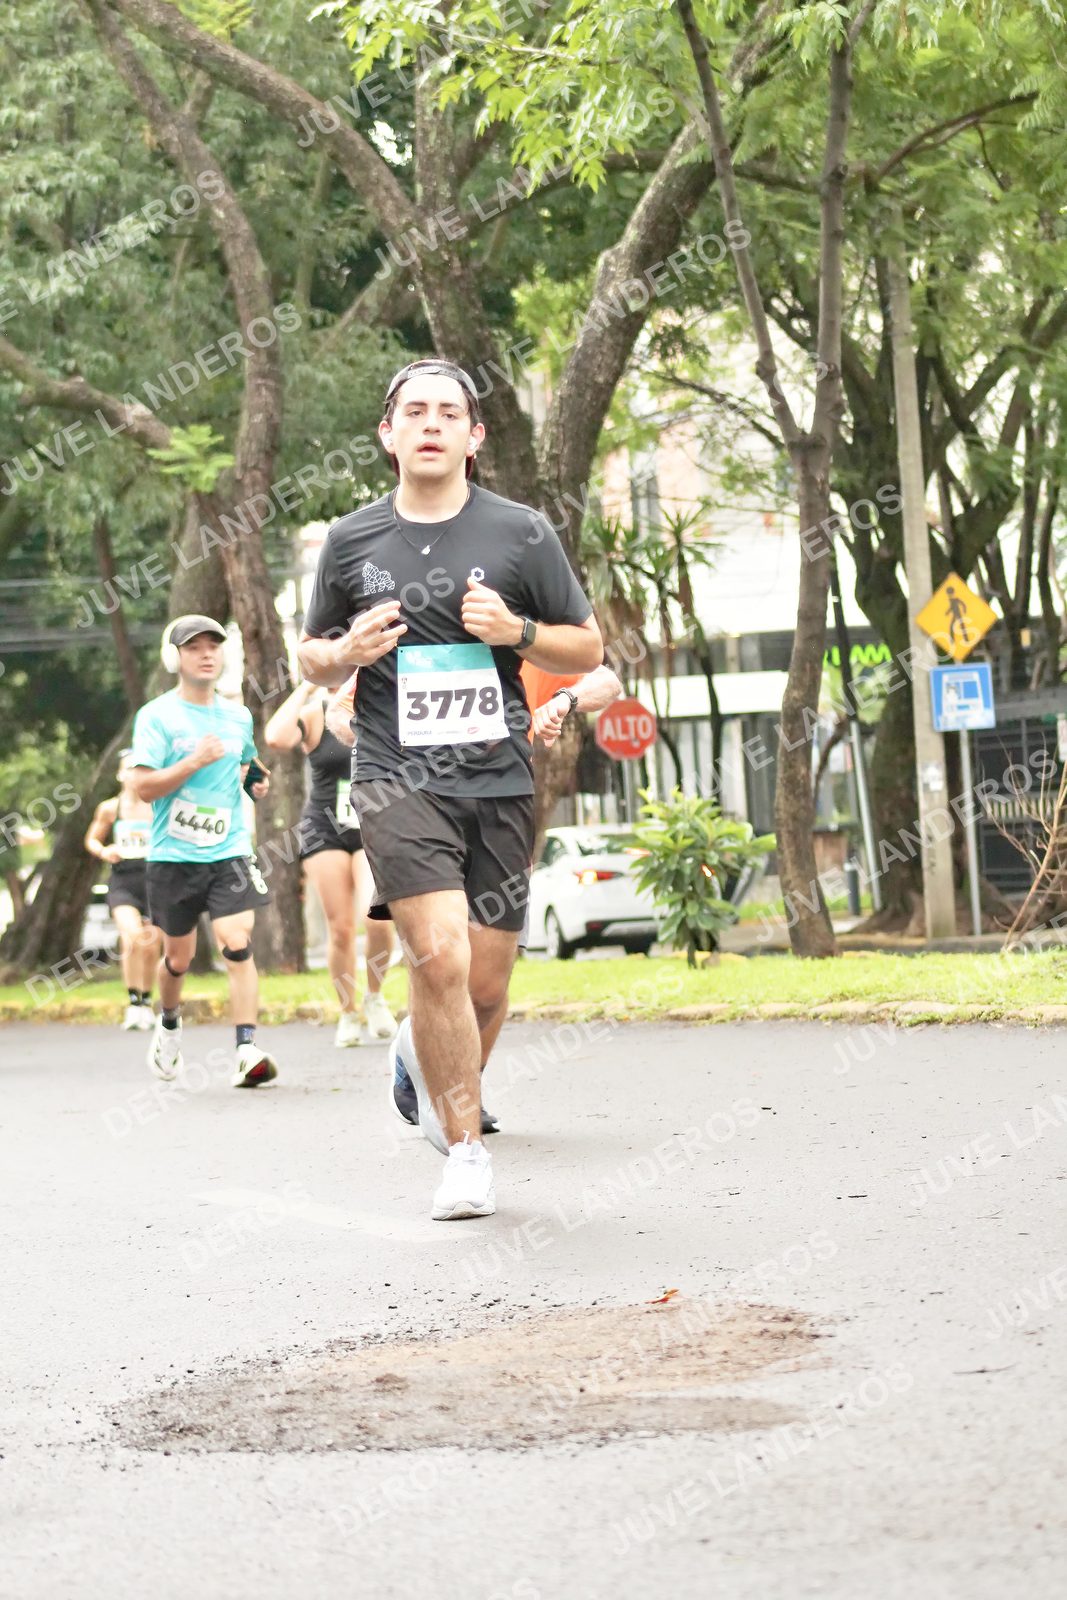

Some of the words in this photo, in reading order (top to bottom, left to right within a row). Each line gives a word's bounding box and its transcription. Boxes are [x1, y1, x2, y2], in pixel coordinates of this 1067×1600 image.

[406, 686, 500, 721] 3778
[603, 715, 652, 741] ALTO
[174, 810, 225, 835] 4440
